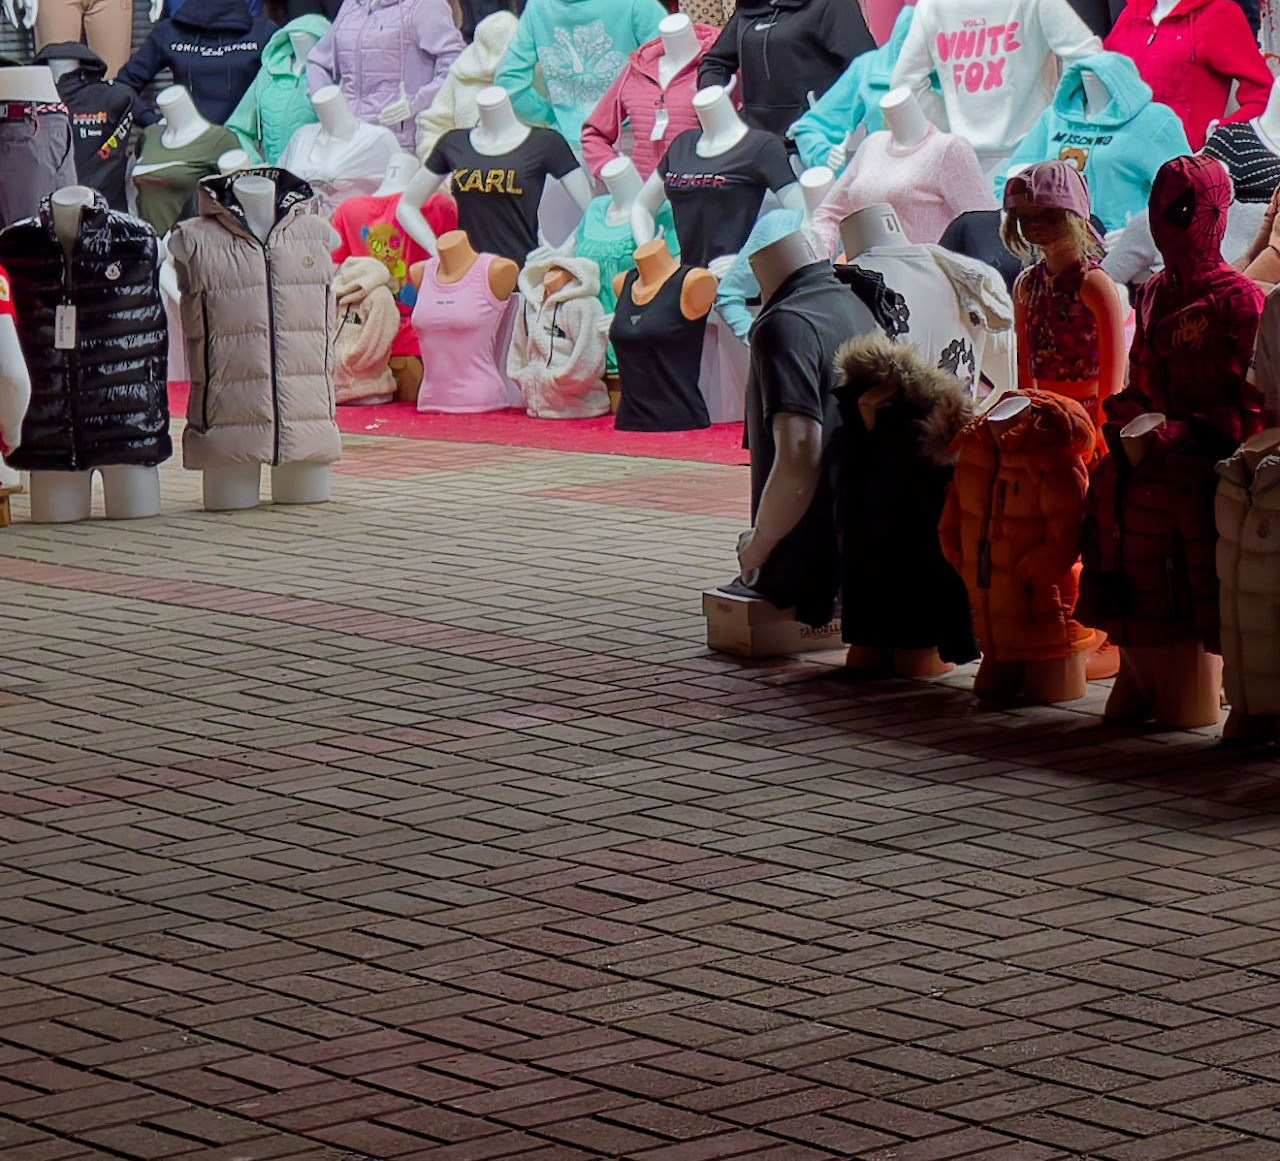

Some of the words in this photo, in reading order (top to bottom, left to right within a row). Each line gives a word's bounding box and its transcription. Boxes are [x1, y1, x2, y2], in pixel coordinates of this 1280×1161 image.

[961, 18, 987, 28] VOL.3
[936, 21, 1021, 63] WHITE
[952, 56, 1006, 94] FOX
[450, 168, 523, 195] KARL
